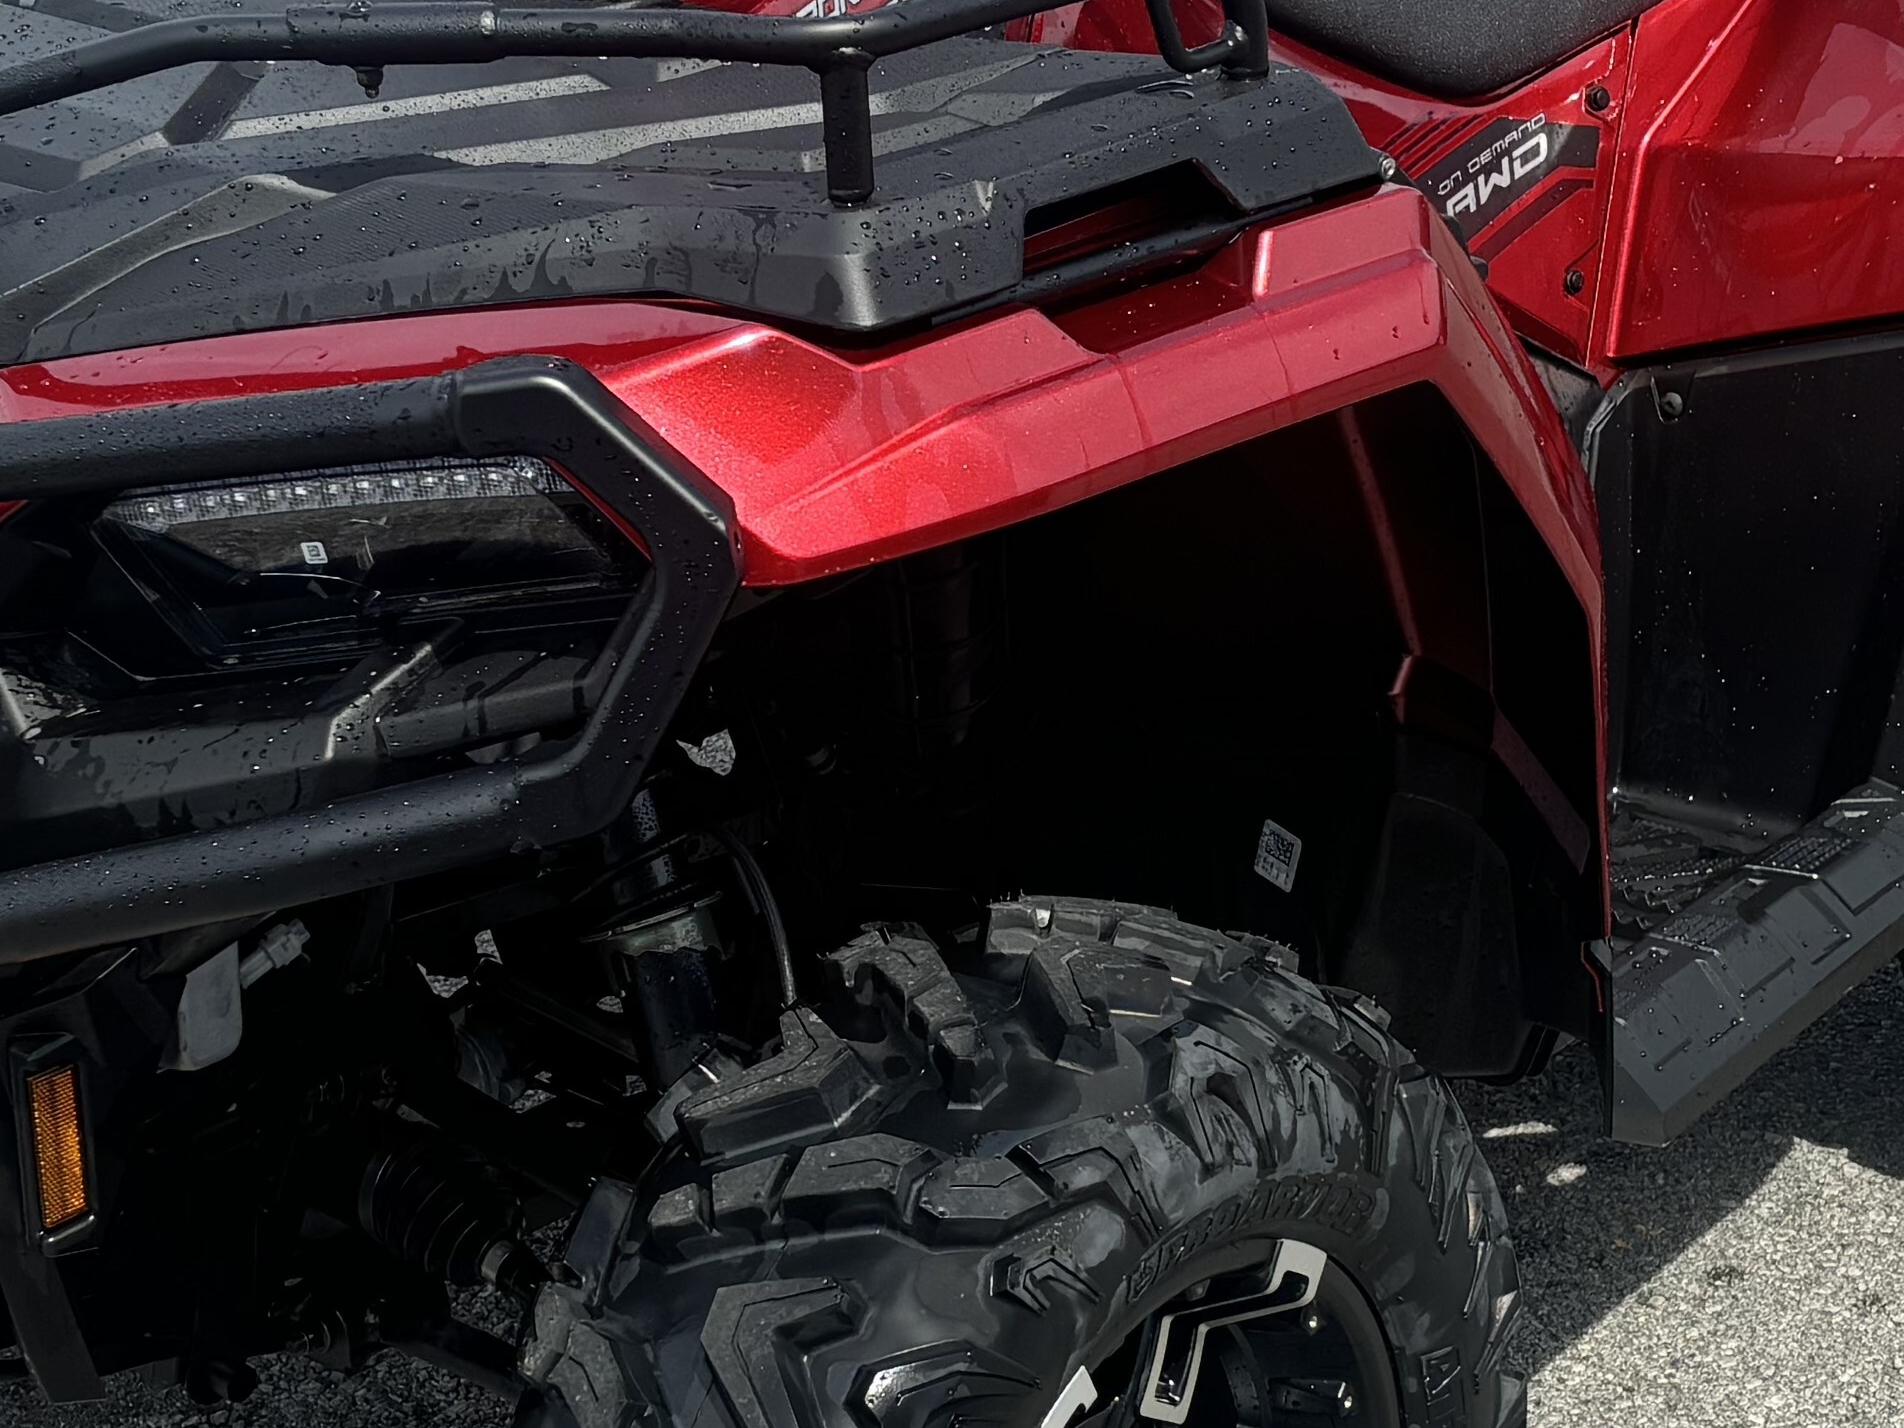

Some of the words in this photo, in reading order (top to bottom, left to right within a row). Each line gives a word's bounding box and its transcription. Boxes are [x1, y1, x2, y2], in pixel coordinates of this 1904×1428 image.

[1437, 170, 1462, 195] ON
[1467, 112, 1546, 174] DEMAND
[1446, 132, 1548, 218] AWD
